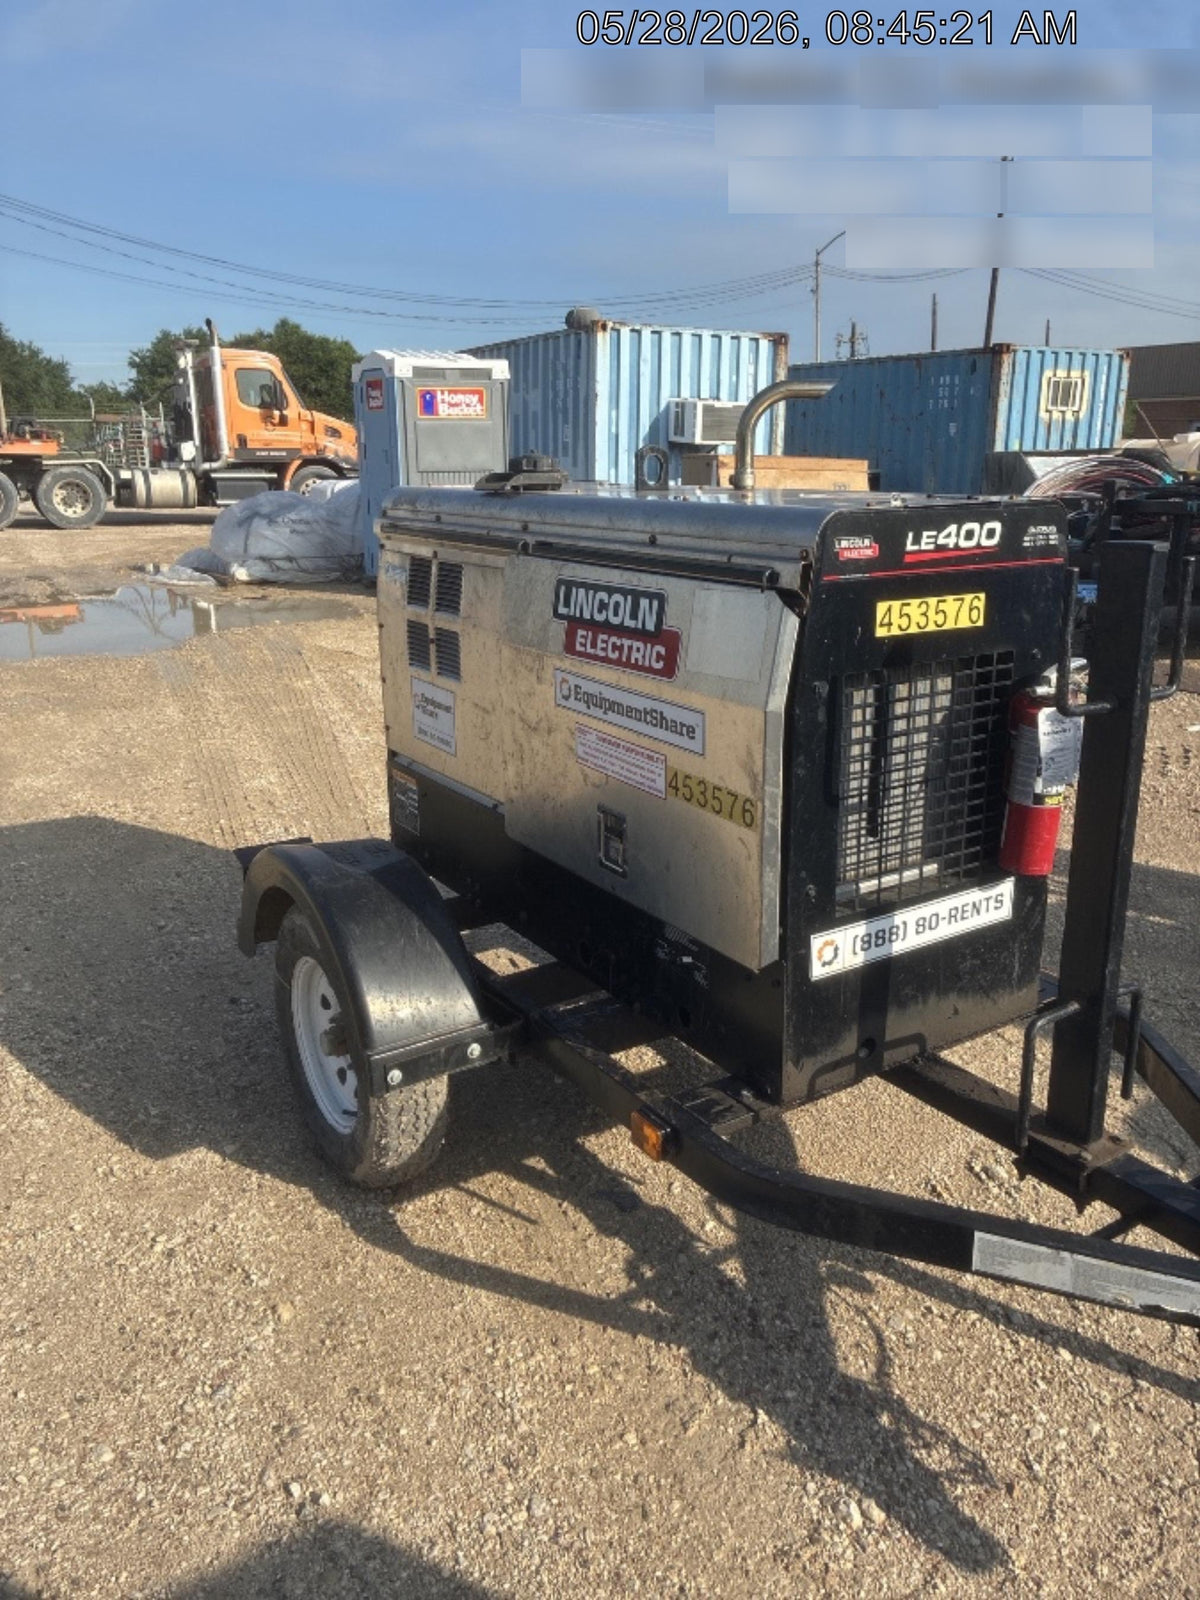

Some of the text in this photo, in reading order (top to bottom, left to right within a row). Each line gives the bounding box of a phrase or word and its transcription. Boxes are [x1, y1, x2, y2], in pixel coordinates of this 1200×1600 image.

[906, 521, 1002, 551] LE400
[558, 585, 659, 632] LINCOLN
[878, 595, 983, 634] 453576
[575, 629, 666, 669] ELECTRIC
[573, 684, 697, 740] EquipmentShare
[668, 771, 755, 827] 453576
[852, 893, 1004, 956] (888) 80-RENTS
